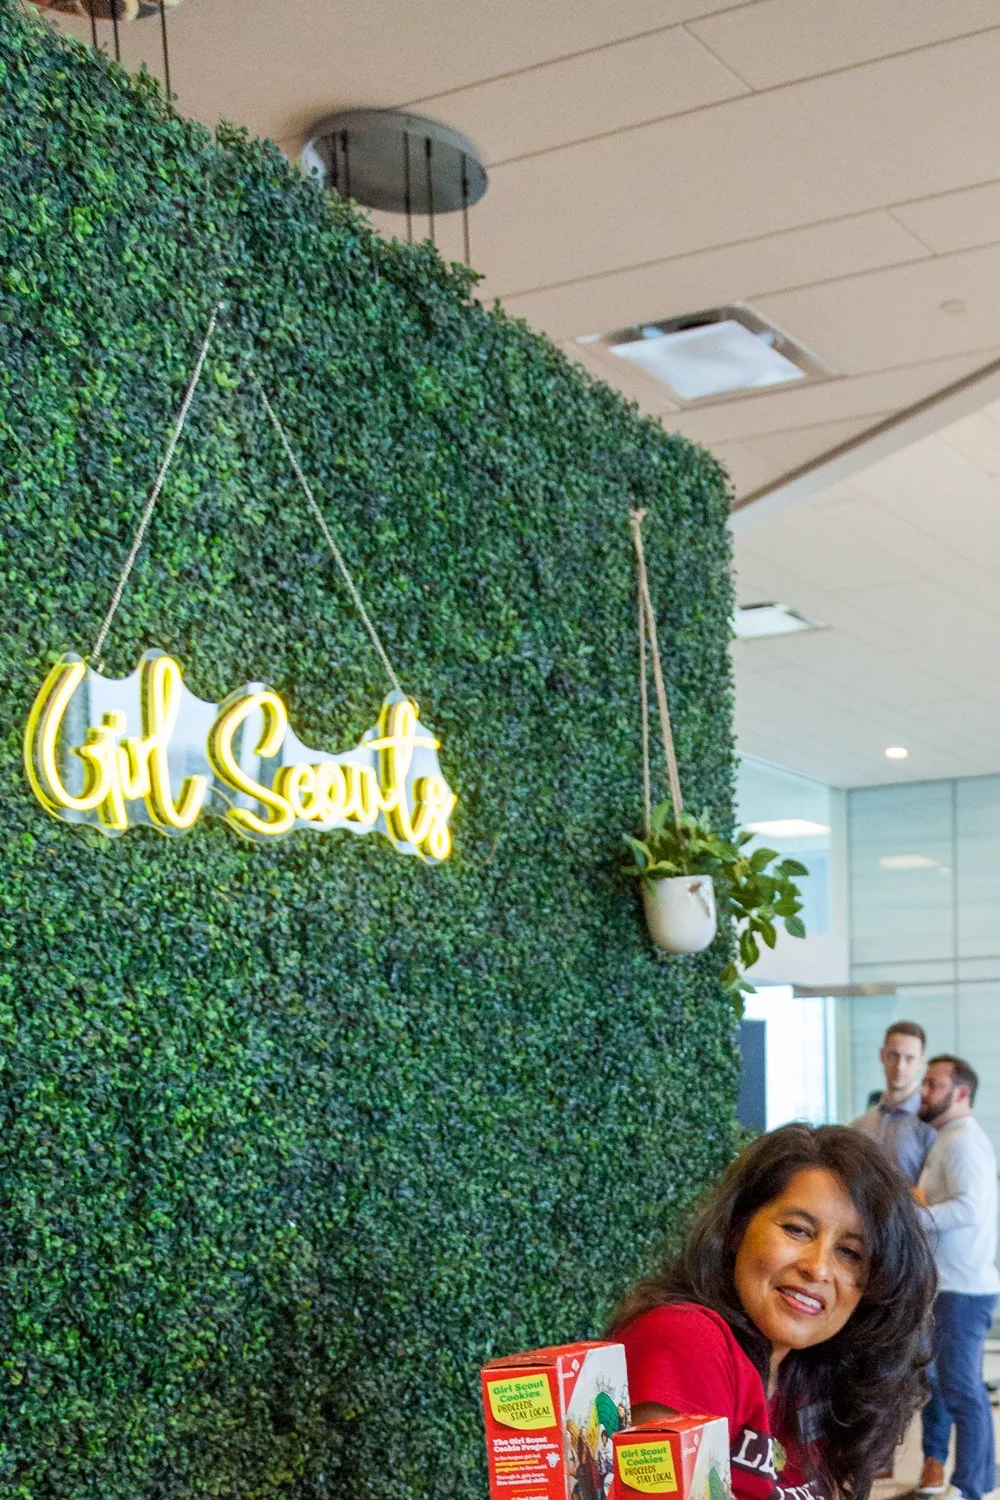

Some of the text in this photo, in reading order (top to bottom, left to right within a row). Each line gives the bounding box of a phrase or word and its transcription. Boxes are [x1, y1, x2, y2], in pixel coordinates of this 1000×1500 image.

[24, 655, 457, 861] Girl Scouts
[493, 1380, 544, 1395] Girl Scout
[500, 1390, 541, 1403] Cookies
[498, 1400, 533, 1413] PROCEEDS
[511, 1406, 551, 1421] STAY LOCAL
[621, 1447, 667, 1459] Girl Scout
[626, 1456, 664, 1466] Cookies
[625, 1465, 657, 1476] PROCEEDS
[636, 1471, 672, 1485] STAY LOCAL
